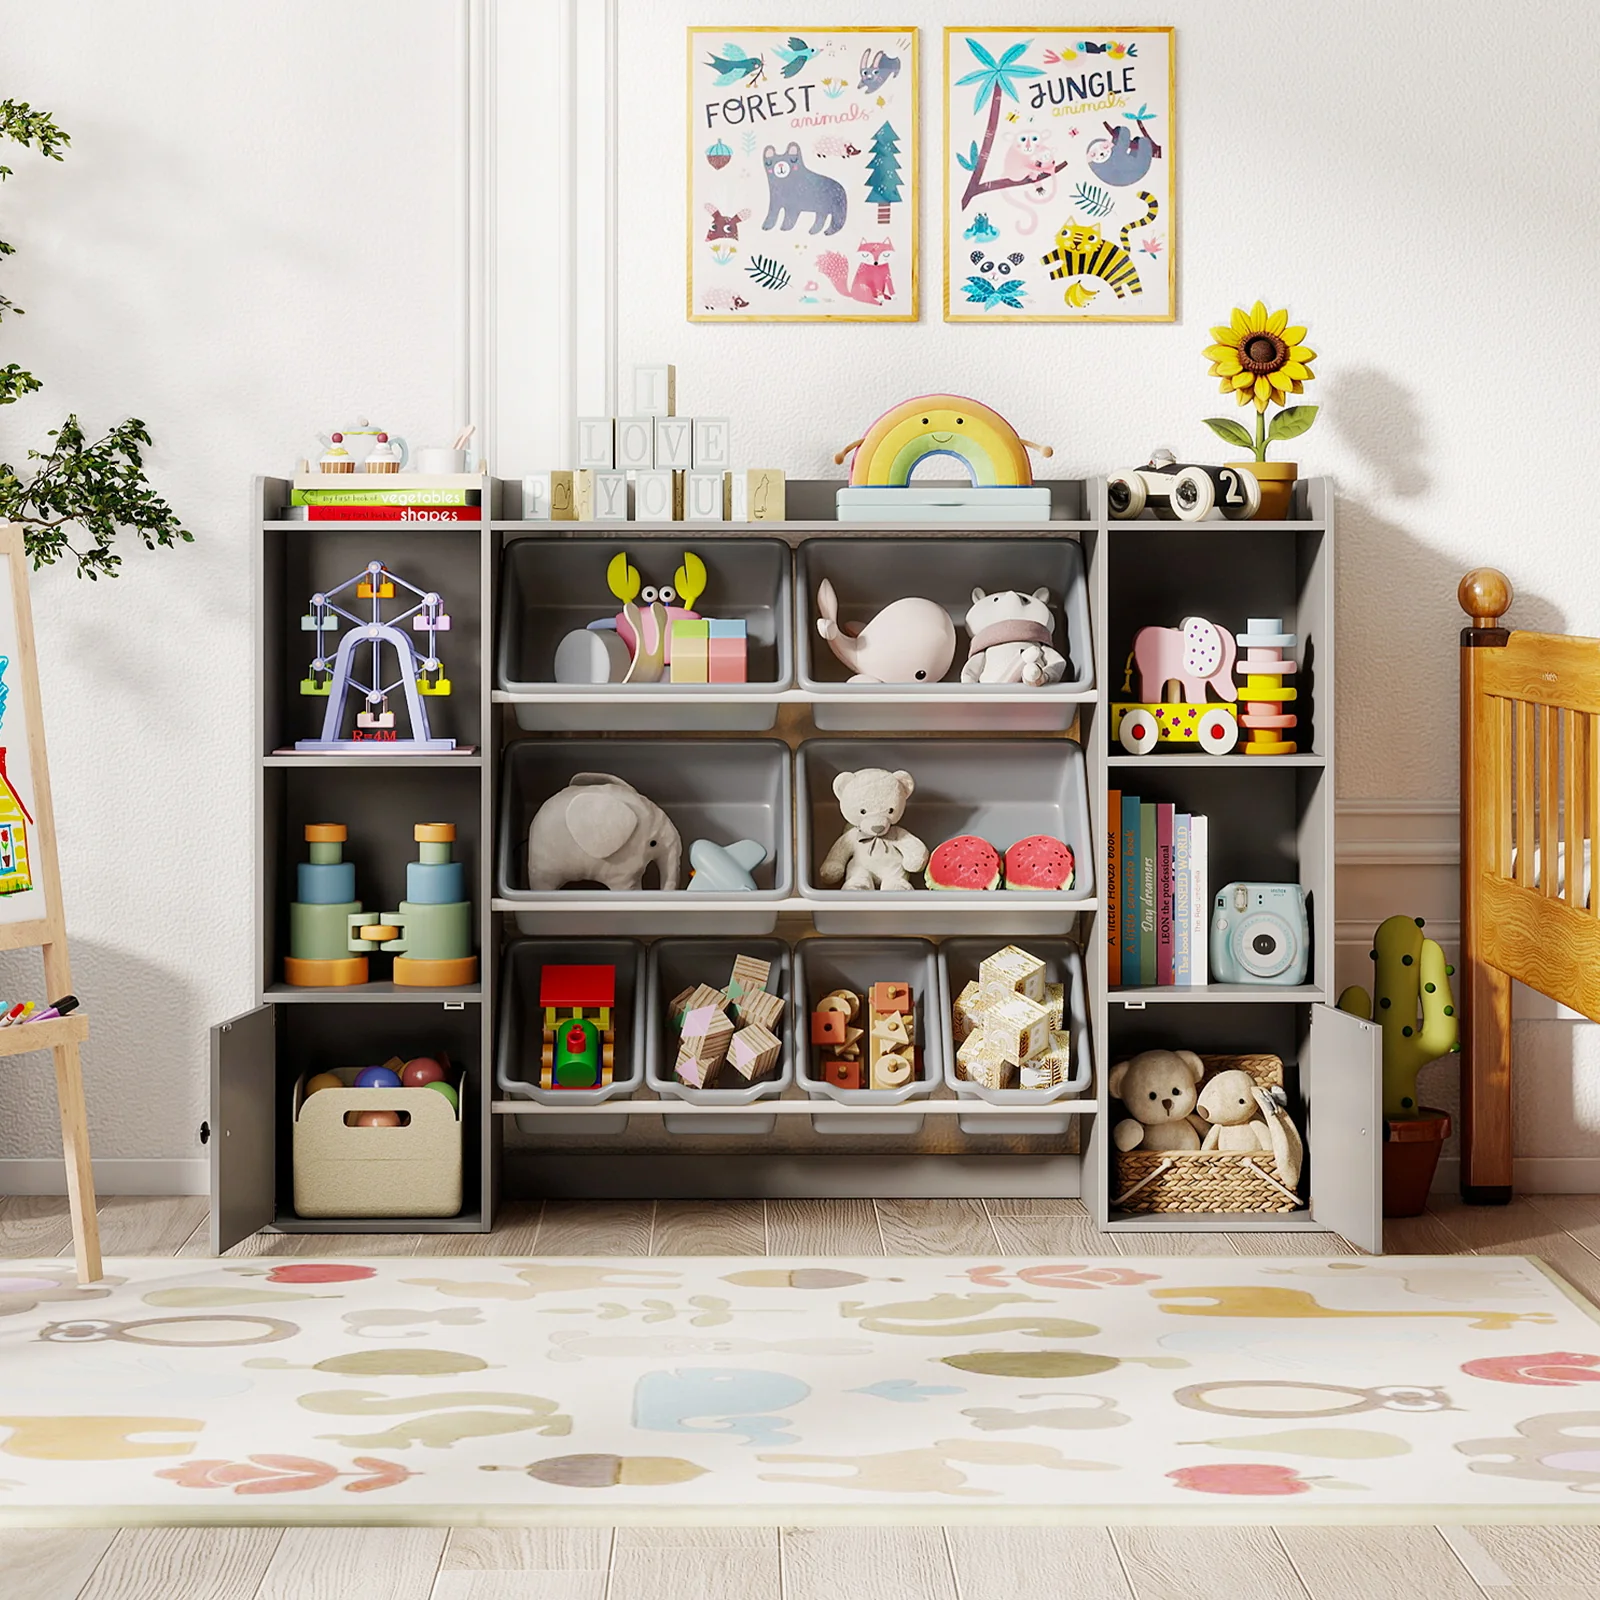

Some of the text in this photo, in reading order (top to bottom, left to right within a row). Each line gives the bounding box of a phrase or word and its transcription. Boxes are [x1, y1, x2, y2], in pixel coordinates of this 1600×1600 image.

[1029, 67, 1136, 109] JUNGLE
[705, 85, 815, 128] FOREST
[790, 103, 872, 129] animals
[1051, 92, 1129, 117] animals
[584, 424, 724, 462] LOVE
[381, 490, 460, 506] vegetables
[1219, 470, 1243, 503] 2
[400, 506, 458, 521] shapes
[1177, 826, 1189, 871] WORLD
[1139, 857, 1157, 932] Day dreamers
[1160, 845, 1172, 945] LEON the professional
[1108, 904, 1116, 931] little
[1124, 914, 1136, 940] little
[1178, 918, 1189, 929] of
[1108, 936, 1116, 946] A
[1125, 944, 1136, 954] A
[1178, 930, 1189, 954] book
[1178, 956, 1189, 975] The
